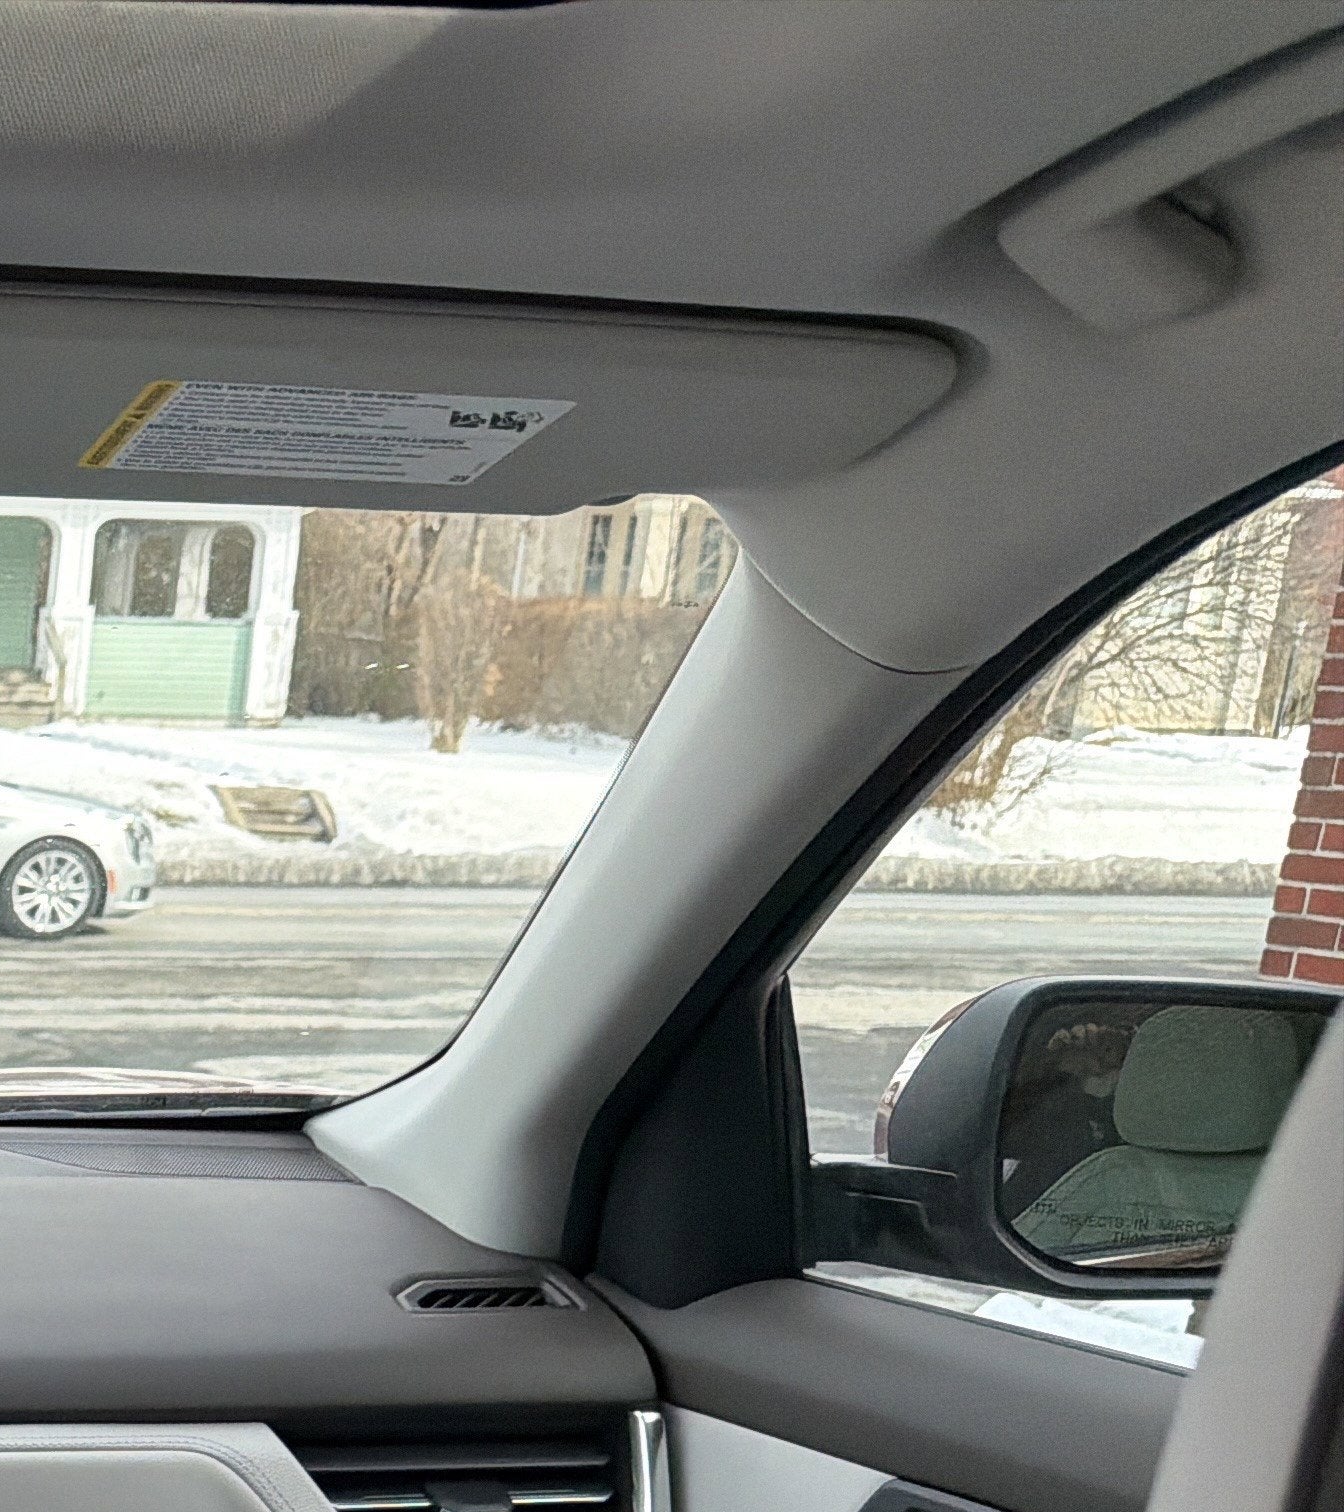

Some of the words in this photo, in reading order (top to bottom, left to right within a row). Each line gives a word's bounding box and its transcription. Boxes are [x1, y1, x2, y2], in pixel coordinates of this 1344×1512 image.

[1059, 1214, 1127, 1228] OBJECTS
[1133, 1217, 1149, 1231] IN
[1160, 1218, 1216, 1233] MIRROR
